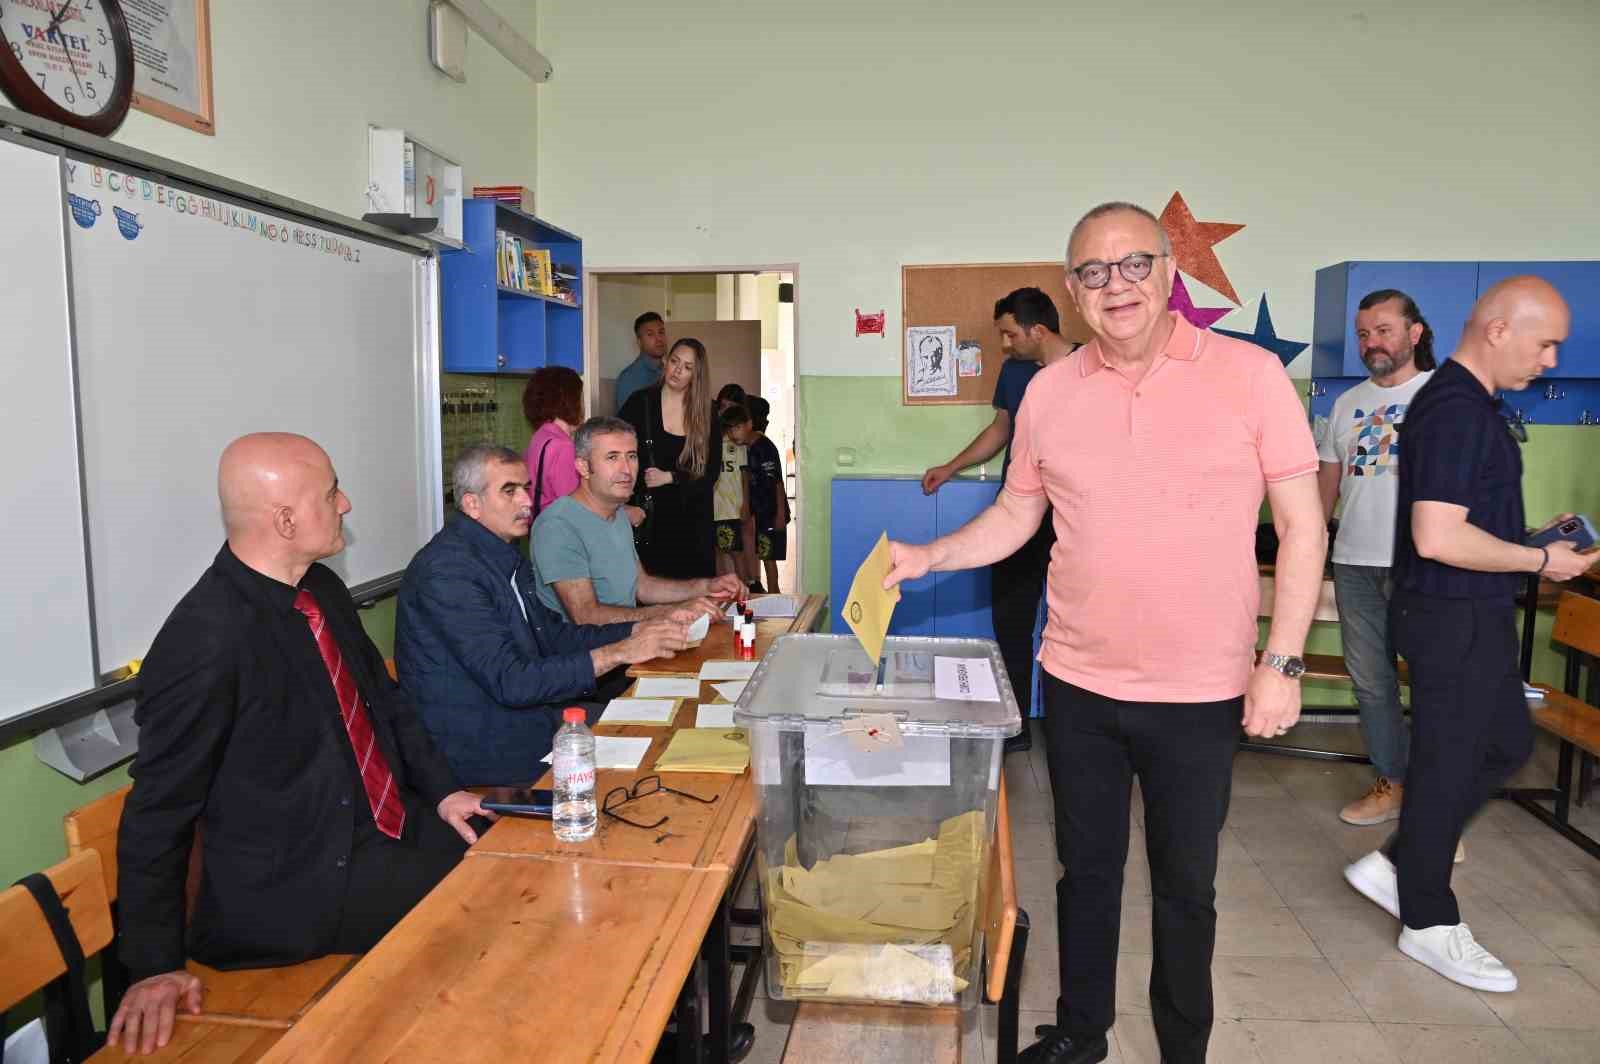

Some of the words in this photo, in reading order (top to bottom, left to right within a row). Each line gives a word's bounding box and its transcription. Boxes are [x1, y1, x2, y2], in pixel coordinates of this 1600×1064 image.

[97, 28, 107, 46] 3
[98, 61, 107, 80] 4
[36, 72, 46, 90] 7
[86, 81, 97, 99] 5
[64, 87, 75, 104] 6
